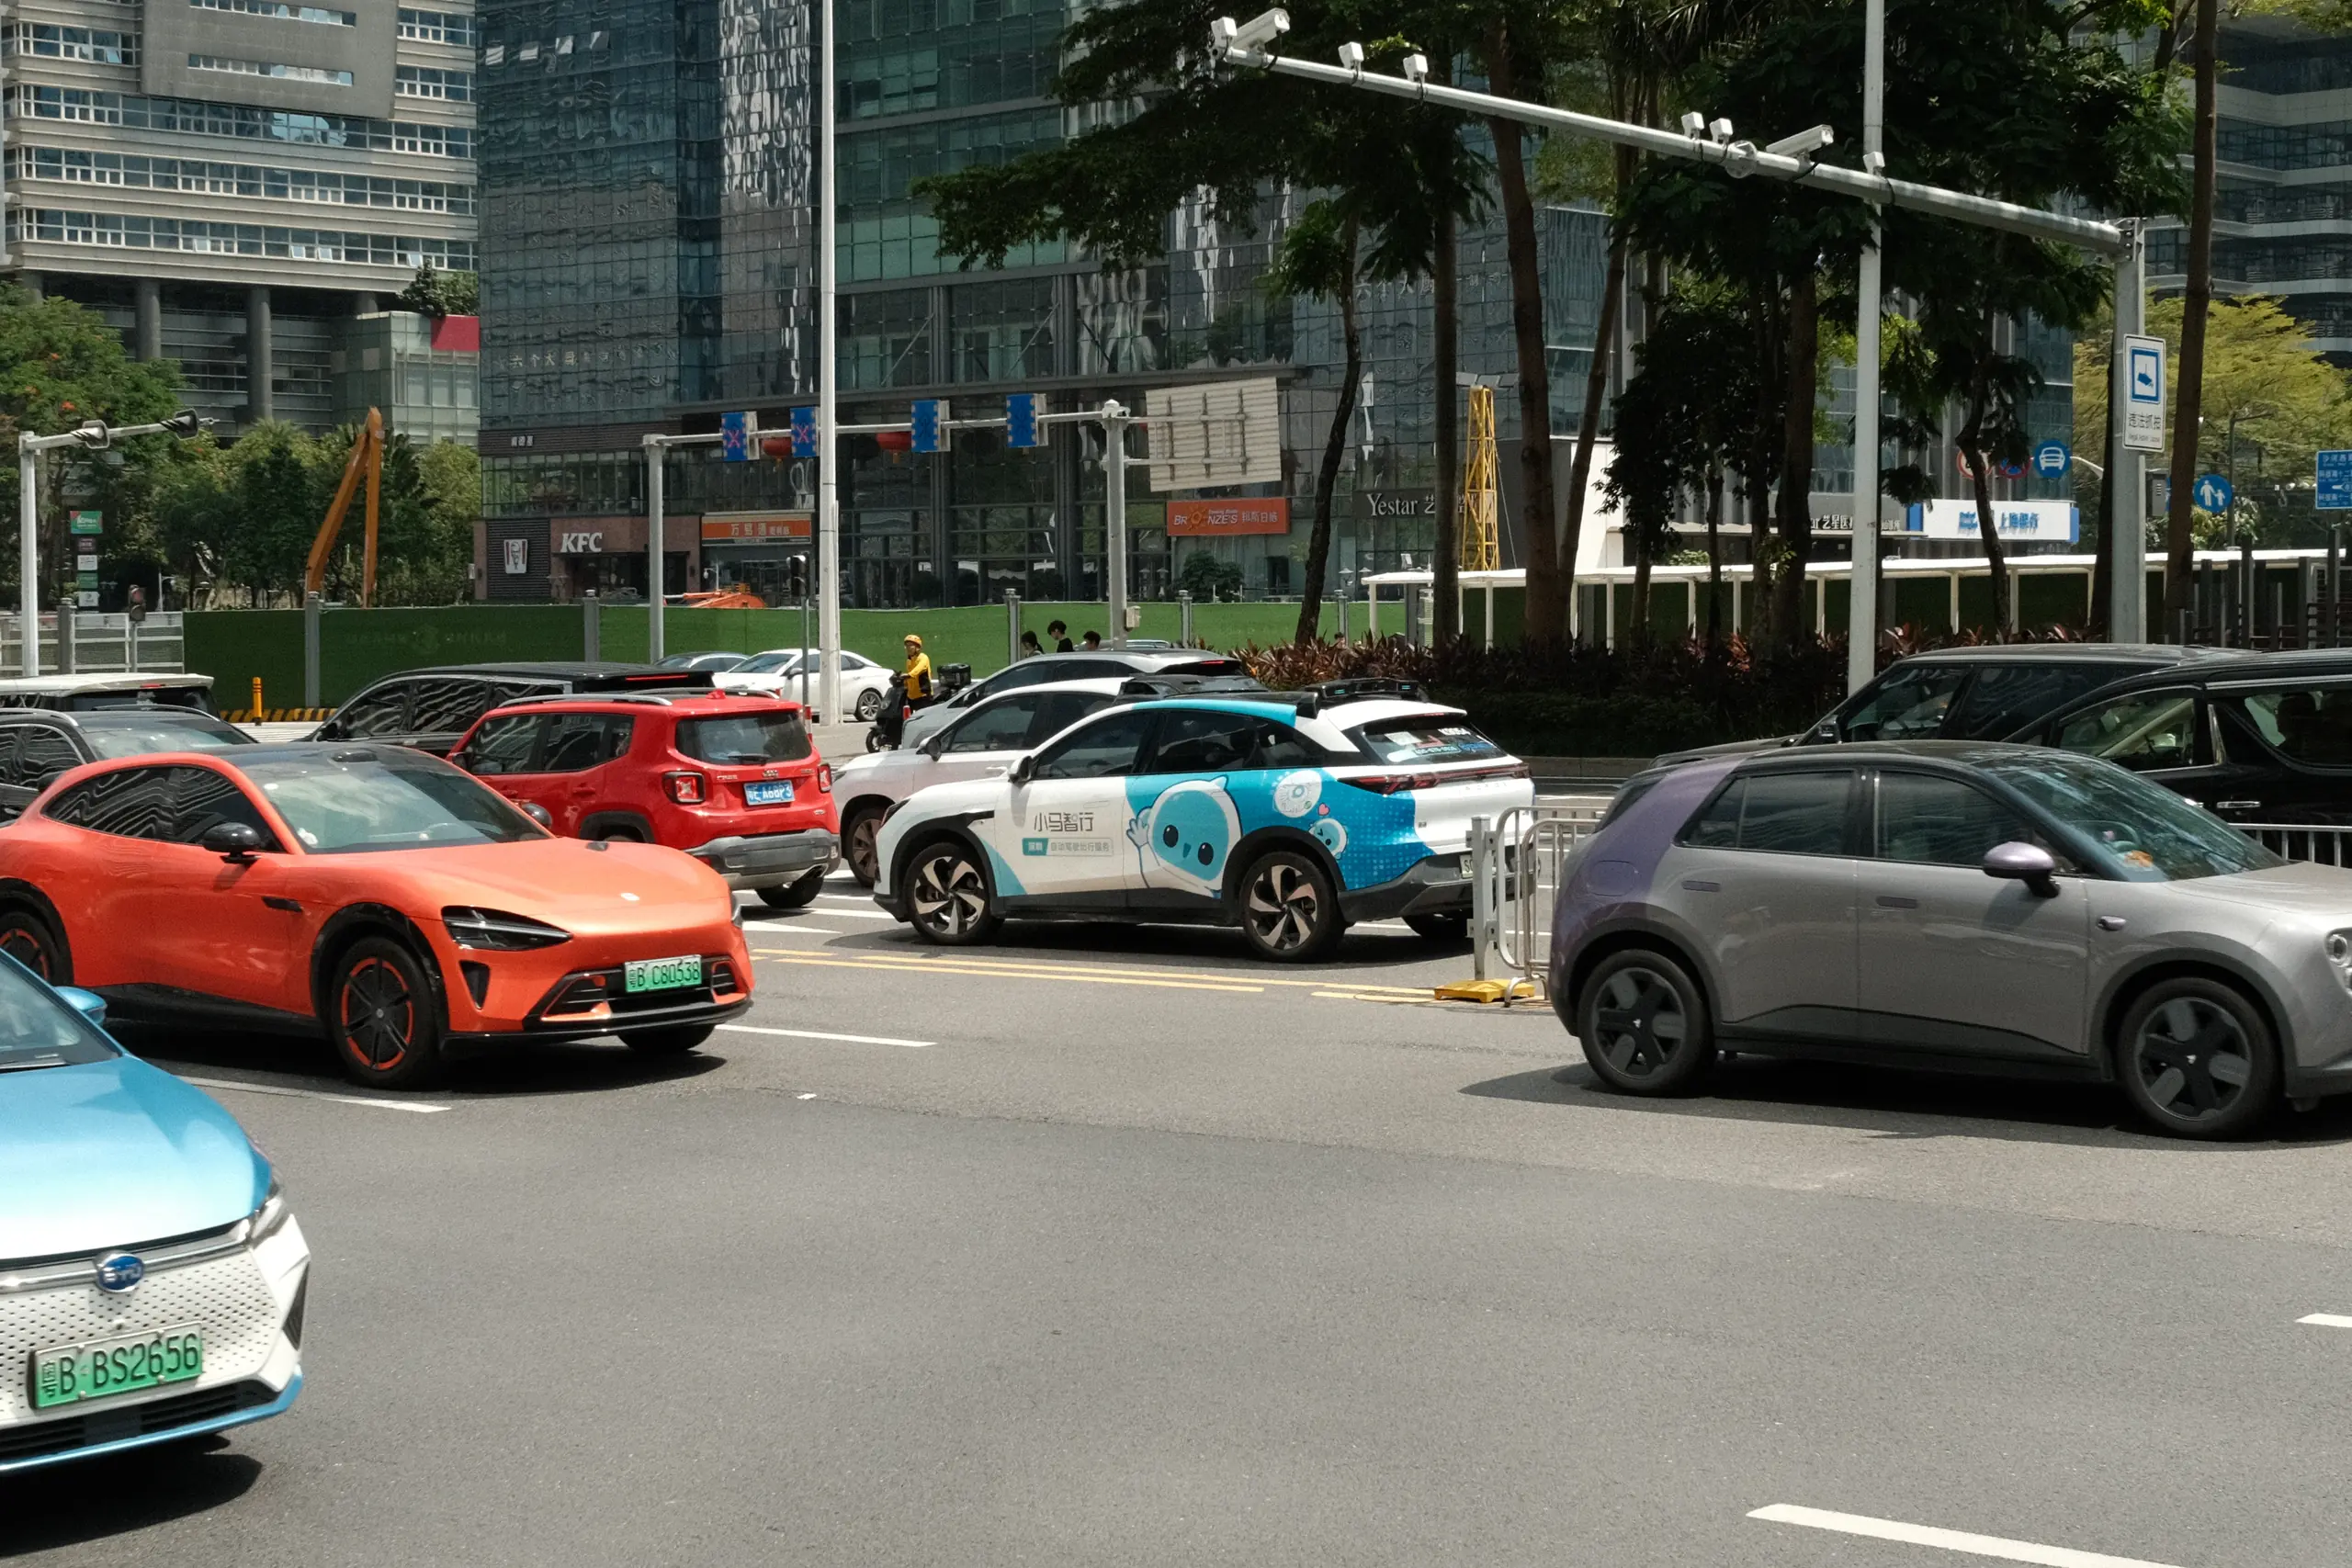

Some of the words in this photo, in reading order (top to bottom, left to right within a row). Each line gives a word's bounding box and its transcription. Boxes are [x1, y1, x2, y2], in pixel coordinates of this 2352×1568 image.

[1366, 492, 1419, 516] Yestar
[560, 532, 603, 553] KFC
[1034, 812, 1094, 832] 小马智行
[652, 961, 700, 985] C80538
[93, 1333, 199, 1389] BS2656
